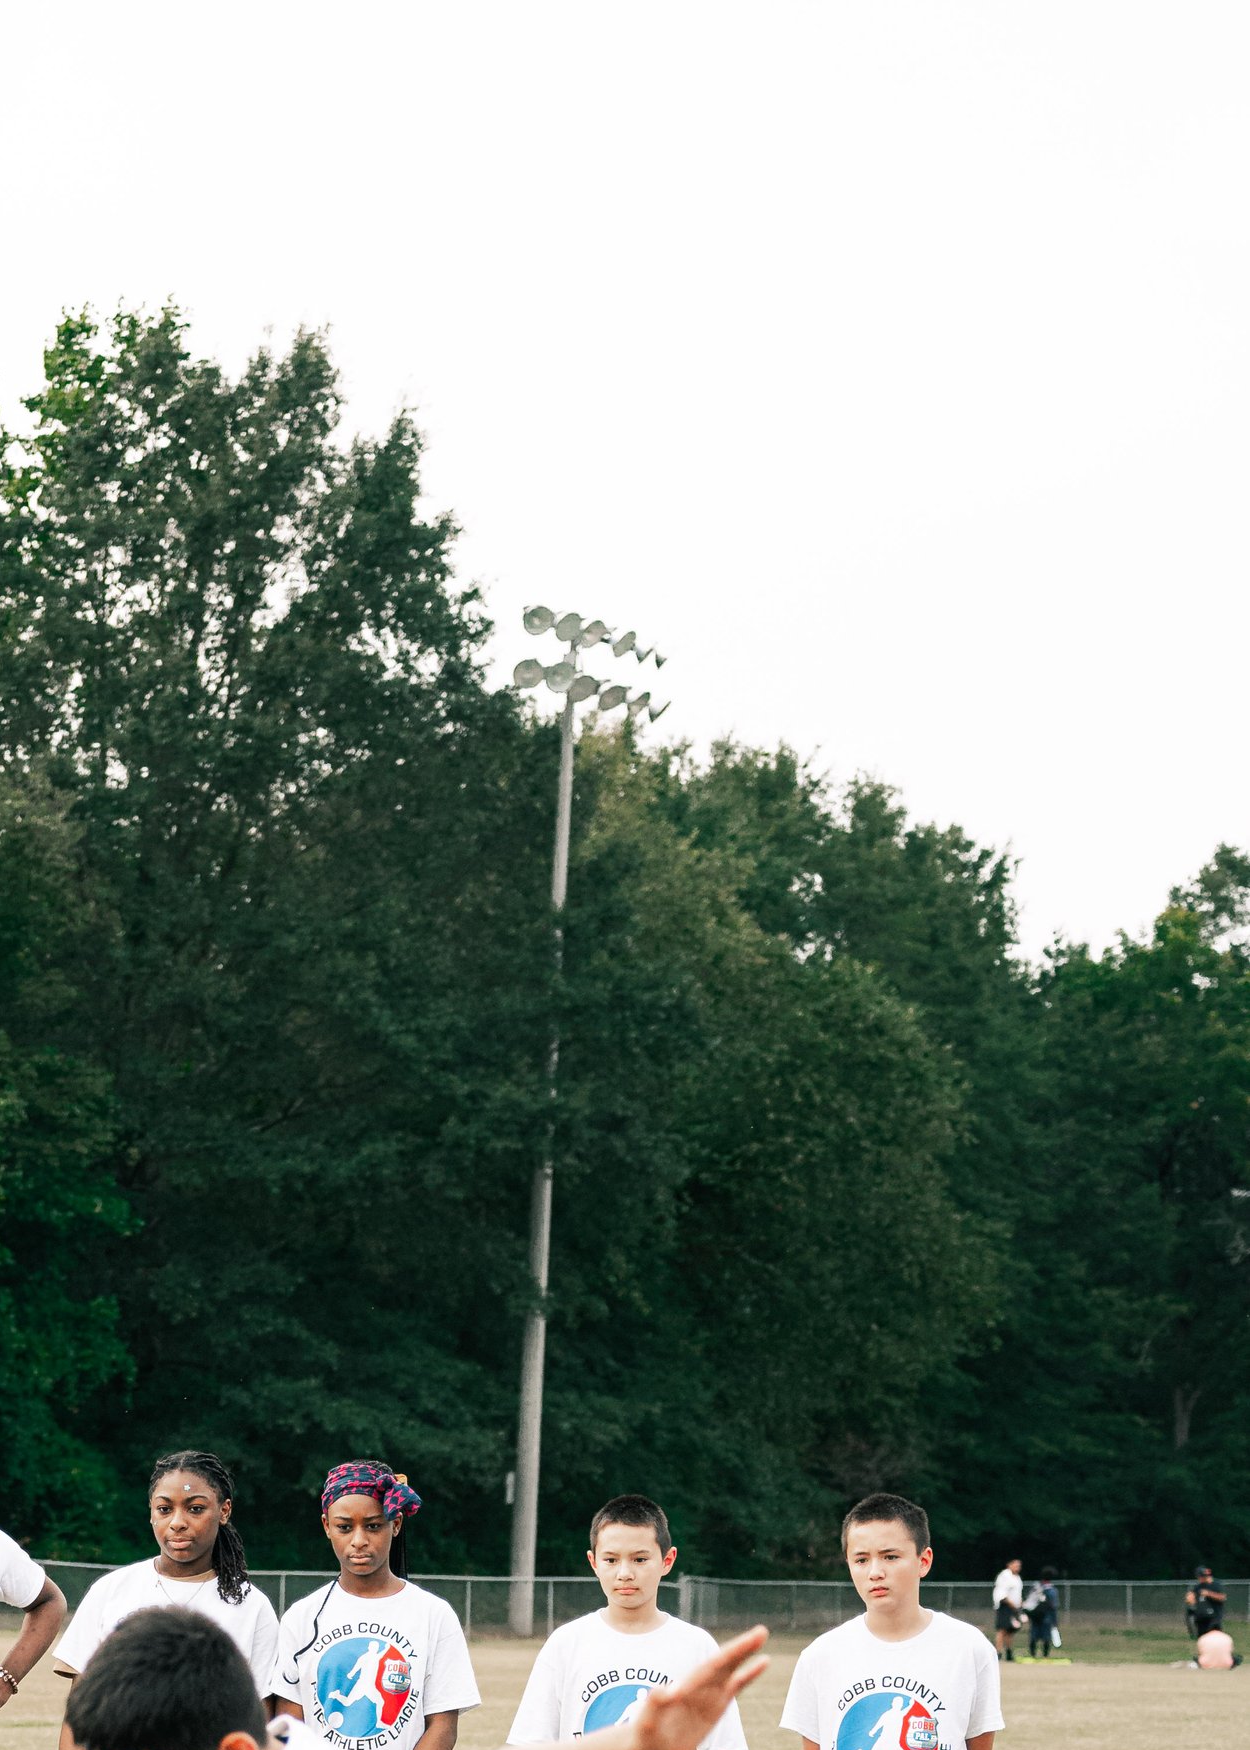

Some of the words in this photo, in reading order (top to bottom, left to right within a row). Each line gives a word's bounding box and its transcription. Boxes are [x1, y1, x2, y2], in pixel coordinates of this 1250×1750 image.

[313, 1624, 353, 1653] COBB
[358, 1622, 418, 1659] COUNTY
[581, 1670, 620, 1702] COBB
[625, 1668, 674, 1686] COUN
[838, 1678, 876, 1711] COBB
[882, 1676, 946, 1713] COUNTY
[324, 1729, 388, 1750] ATHLETIC
[388, 1688, 420, 1740] LEAGUE
[912, 1721, 934, 1730] COBB
[915, 1732, 930, 1740] PAL
